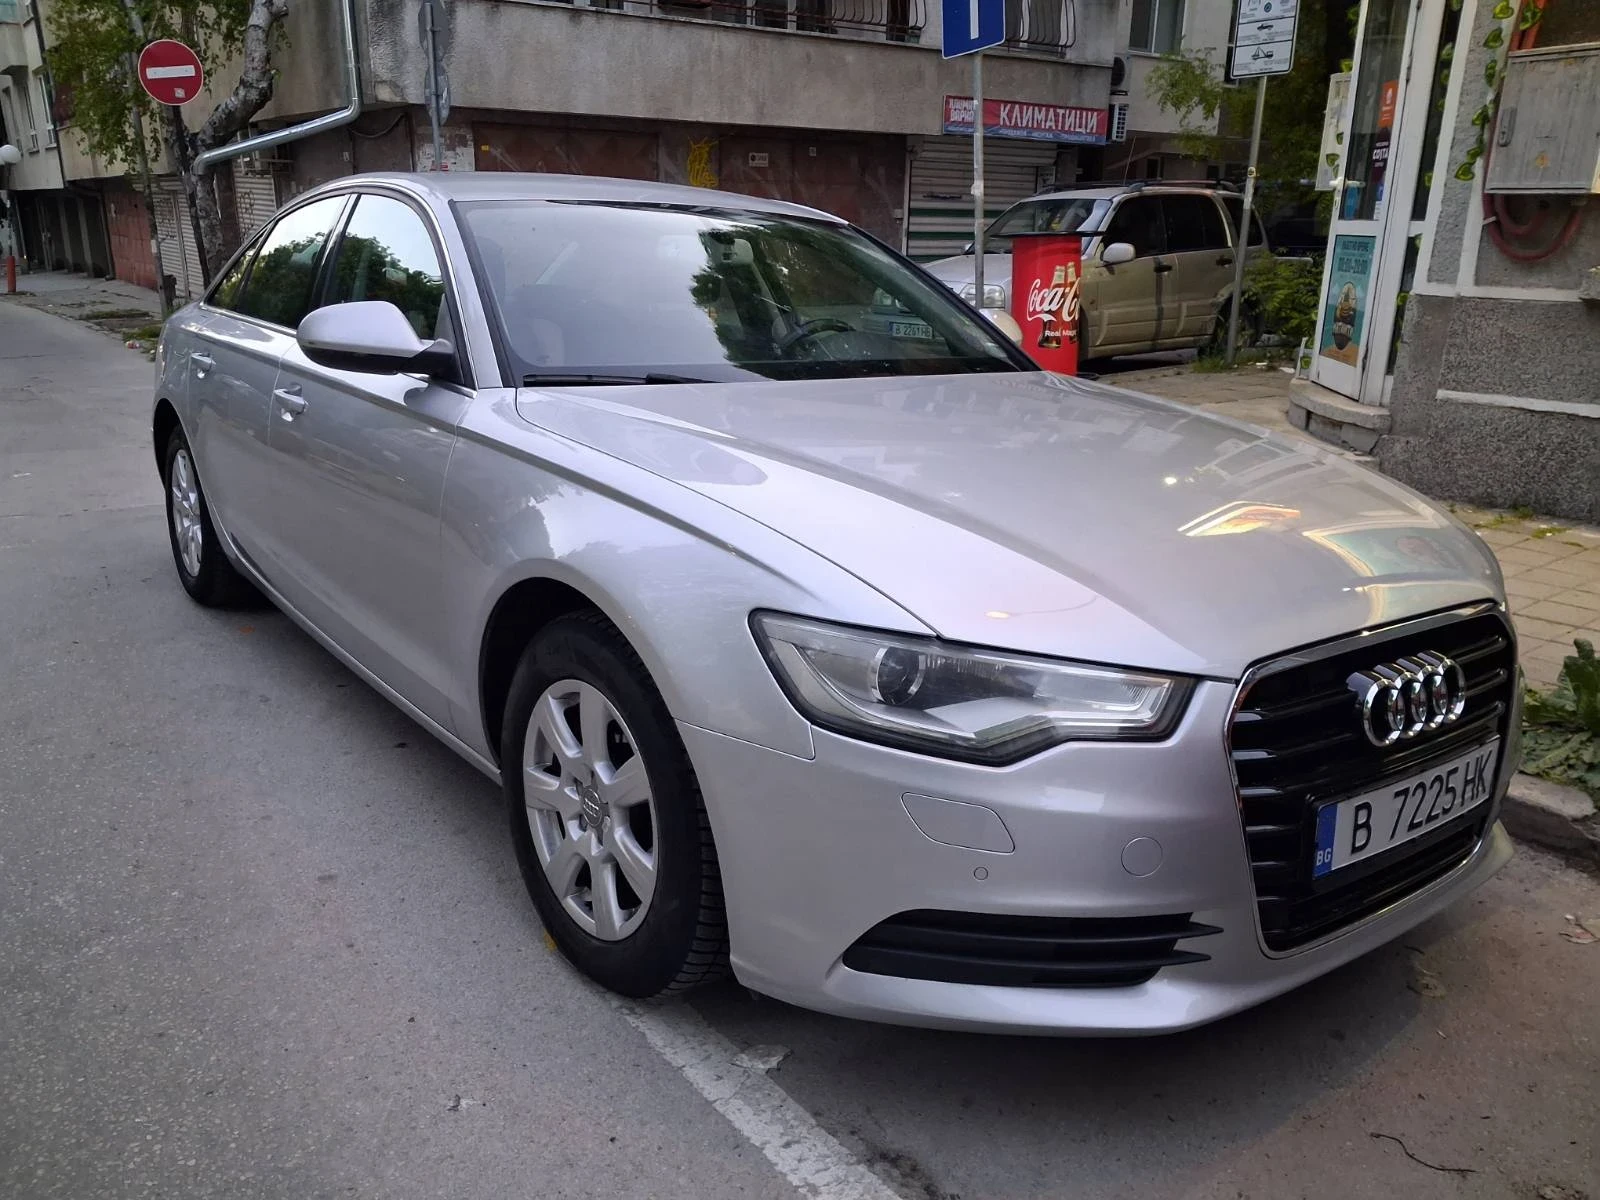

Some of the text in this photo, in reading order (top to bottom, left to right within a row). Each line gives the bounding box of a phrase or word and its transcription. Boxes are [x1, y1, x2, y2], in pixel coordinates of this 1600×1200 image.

[1000, 103, 1097, 133] КЛИМАТИЦИ
[1045, 328, 1061, 337] Real
[1351, 801, 1373, 856] B
[1316, 848, 1332, 866] BG
